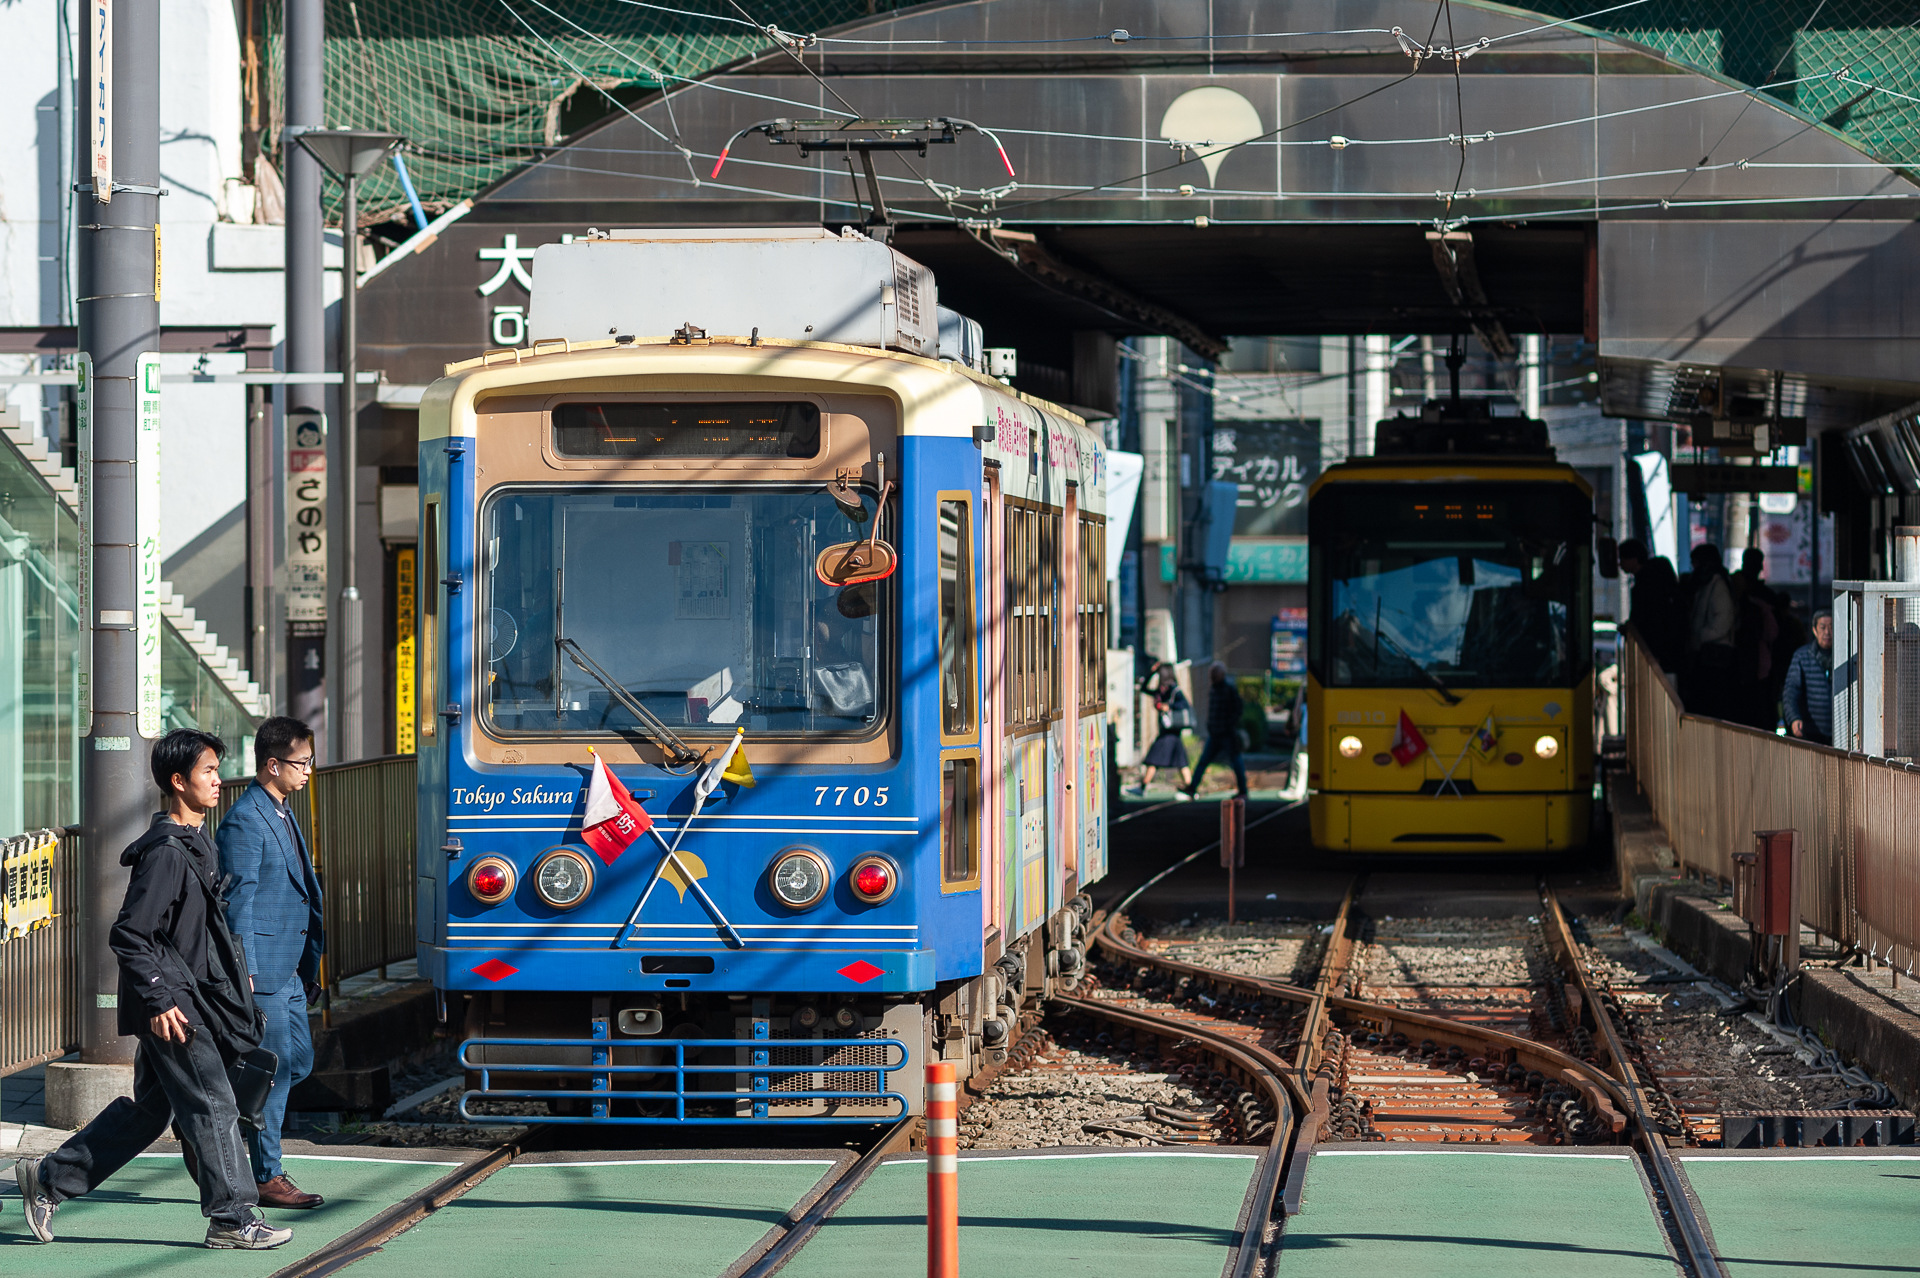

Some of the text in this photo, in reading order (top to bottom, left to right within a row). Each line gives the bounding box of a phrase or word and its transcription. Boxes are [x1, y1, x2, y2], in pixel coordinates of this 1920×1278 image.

[296, 478, 322, 554] さのや
[143, 536, 157, 656] クリニック
[452, 785, 506, 812] Tokyo
[511, 784, 573, 805] Sakura
[814, 786, 890, 807] 7705
[9, 856, 50, 909] 電車注意
